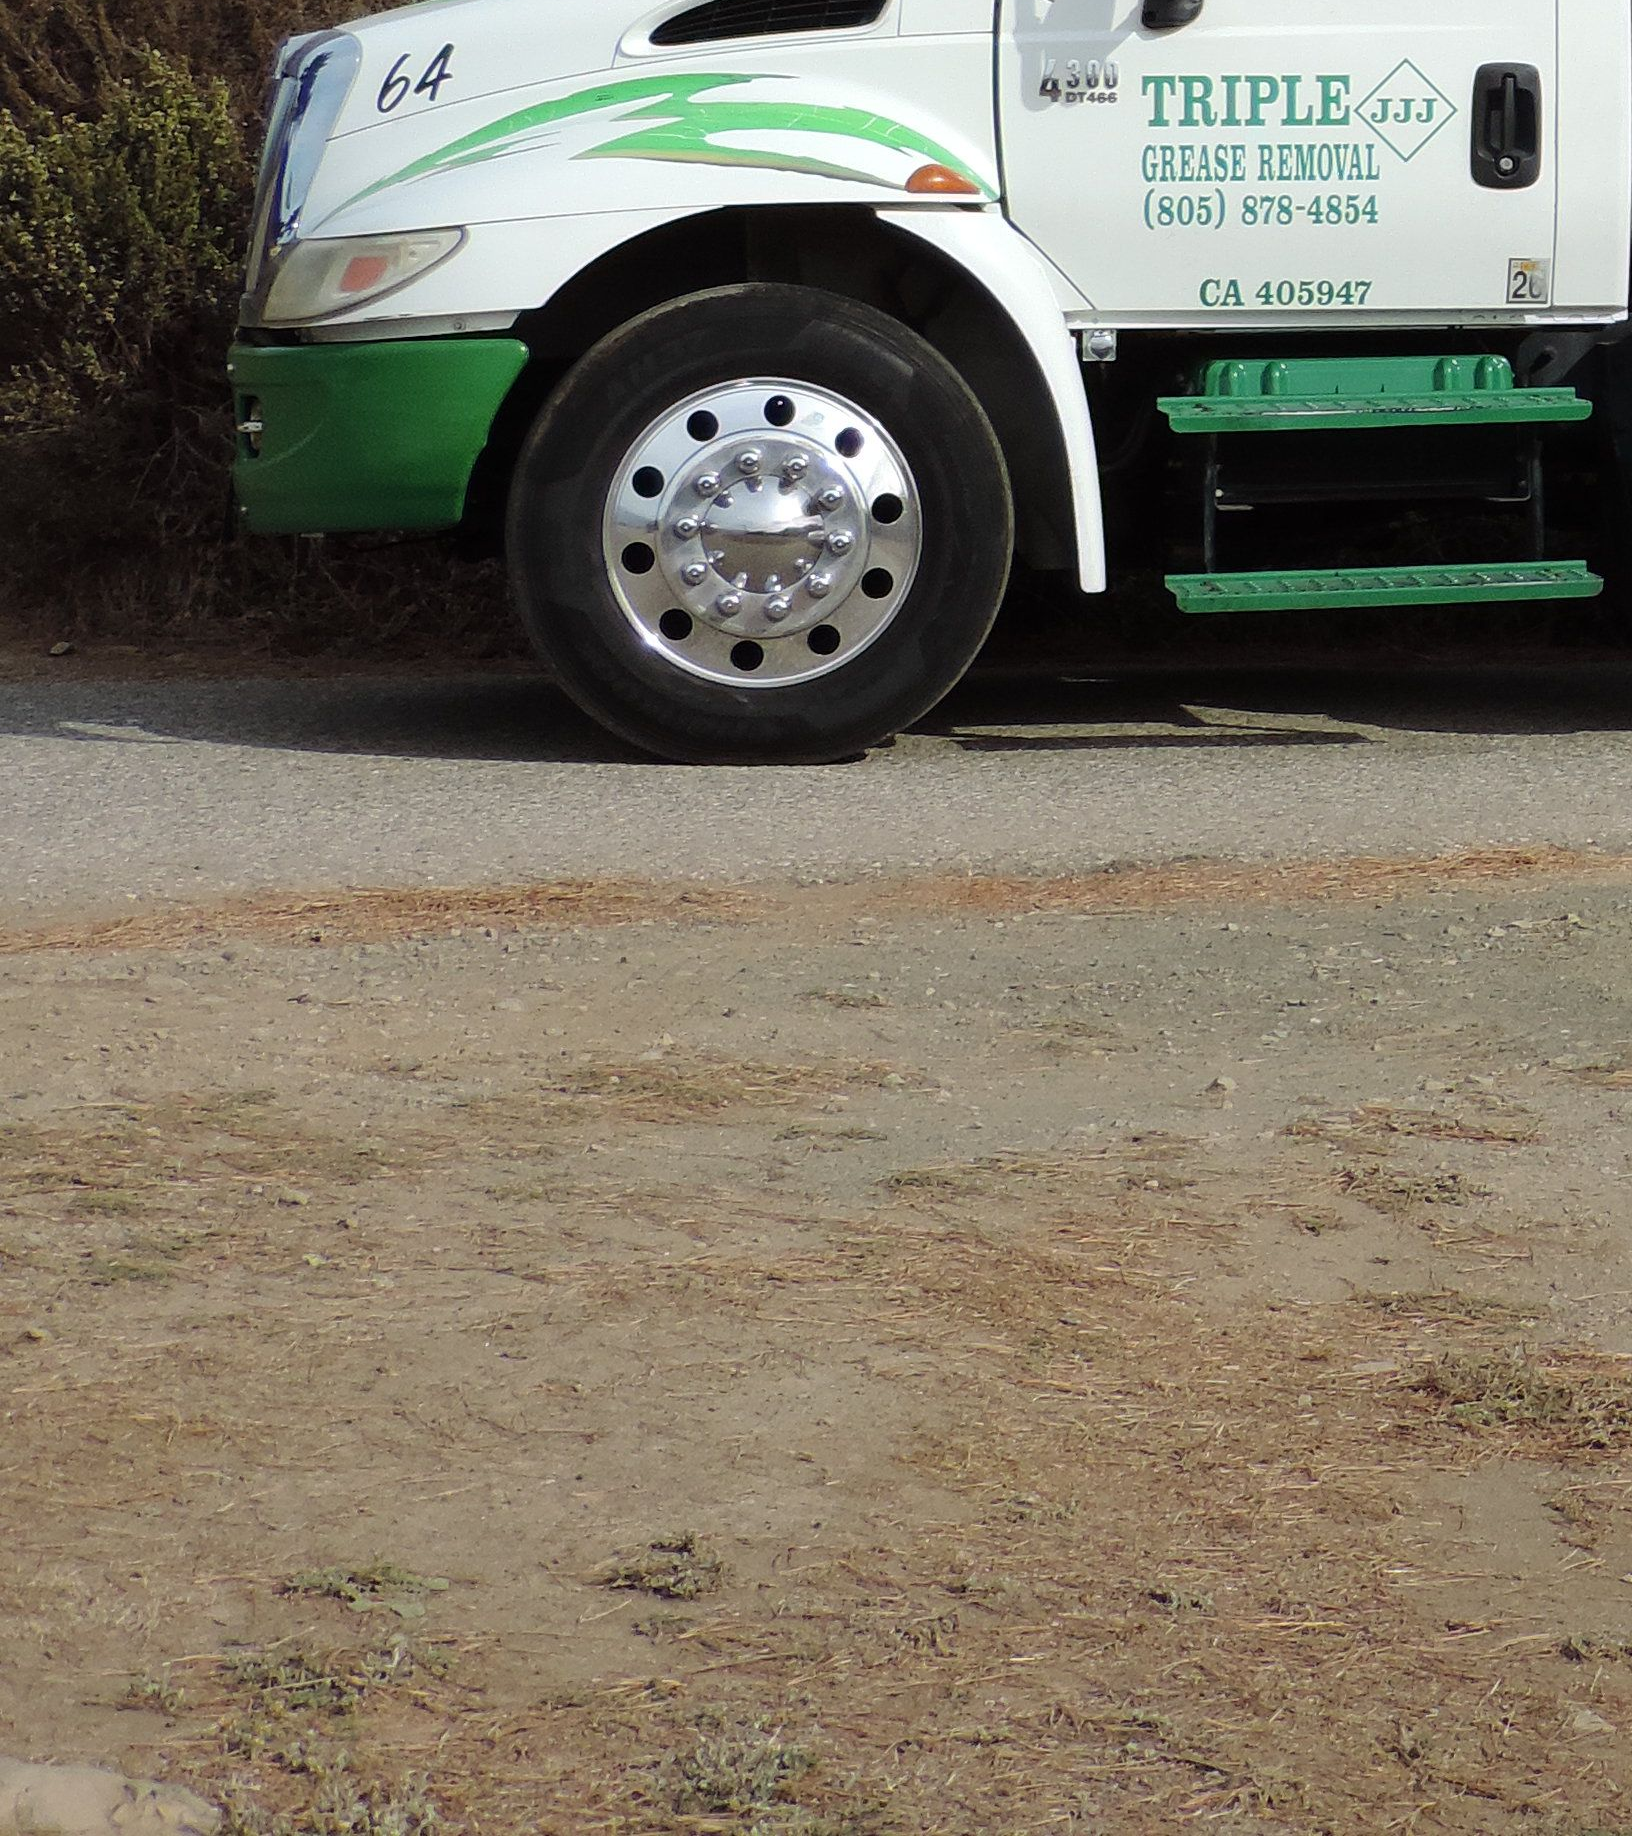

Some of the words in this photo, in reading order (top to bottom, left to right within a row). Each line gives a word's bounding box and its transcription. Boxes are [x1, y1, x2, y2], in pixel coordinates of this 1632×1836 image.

[376, 43, 454, 113] 64
[1039, 58, 1119, 102] 4300
[1065, 92, 1118, 103] DT466
[1141, 75, 1351, 127] TRIPLE
[1370, 98, 1438, 124] JJJ
[1141, 144, 1246, 183] GREASE
[1257, 143, 1380, 182] REMOVAL
[1143, 187, 1226, 230] (805)
[1241, 195, 1379, 225] 878-4854
[1200, 279, 1245, 306] CA
[1255, 281, 1373, 305] 405947
